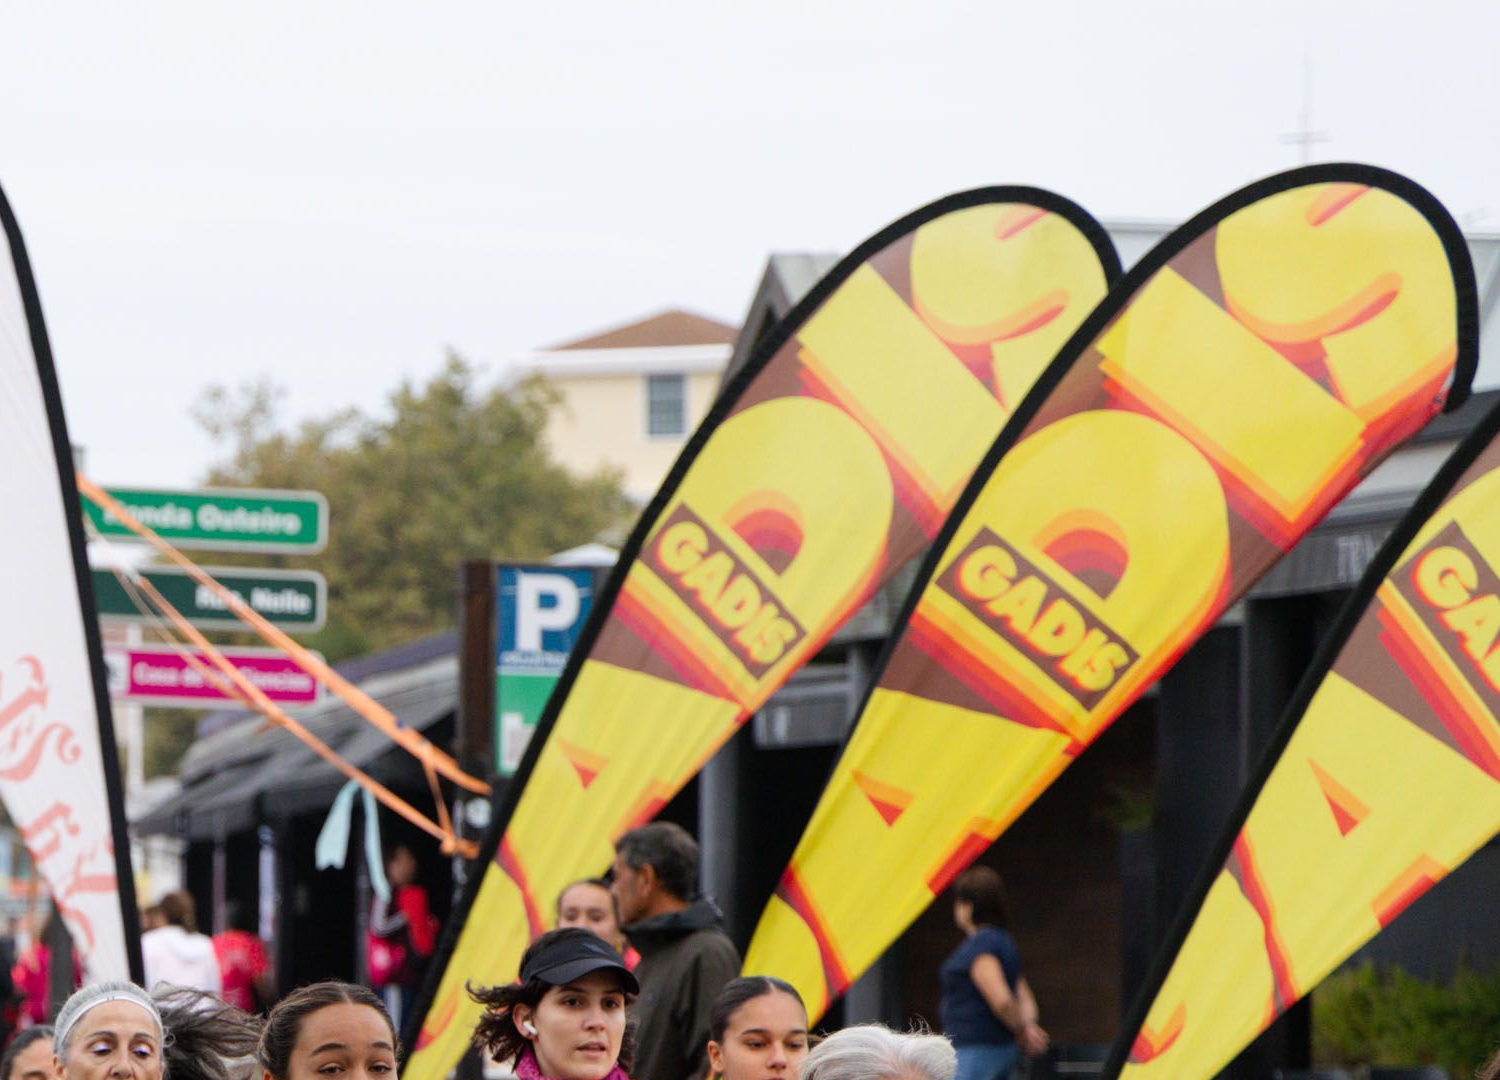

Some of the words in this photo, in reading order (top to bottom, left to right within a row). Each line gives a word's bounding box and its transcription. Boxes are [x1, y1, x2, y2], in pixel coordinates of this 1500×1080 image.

[515, 572, 581, 652] P
[657, 520, 799, 666] GADIS
[955, 544, 1131, 692] GADIS
